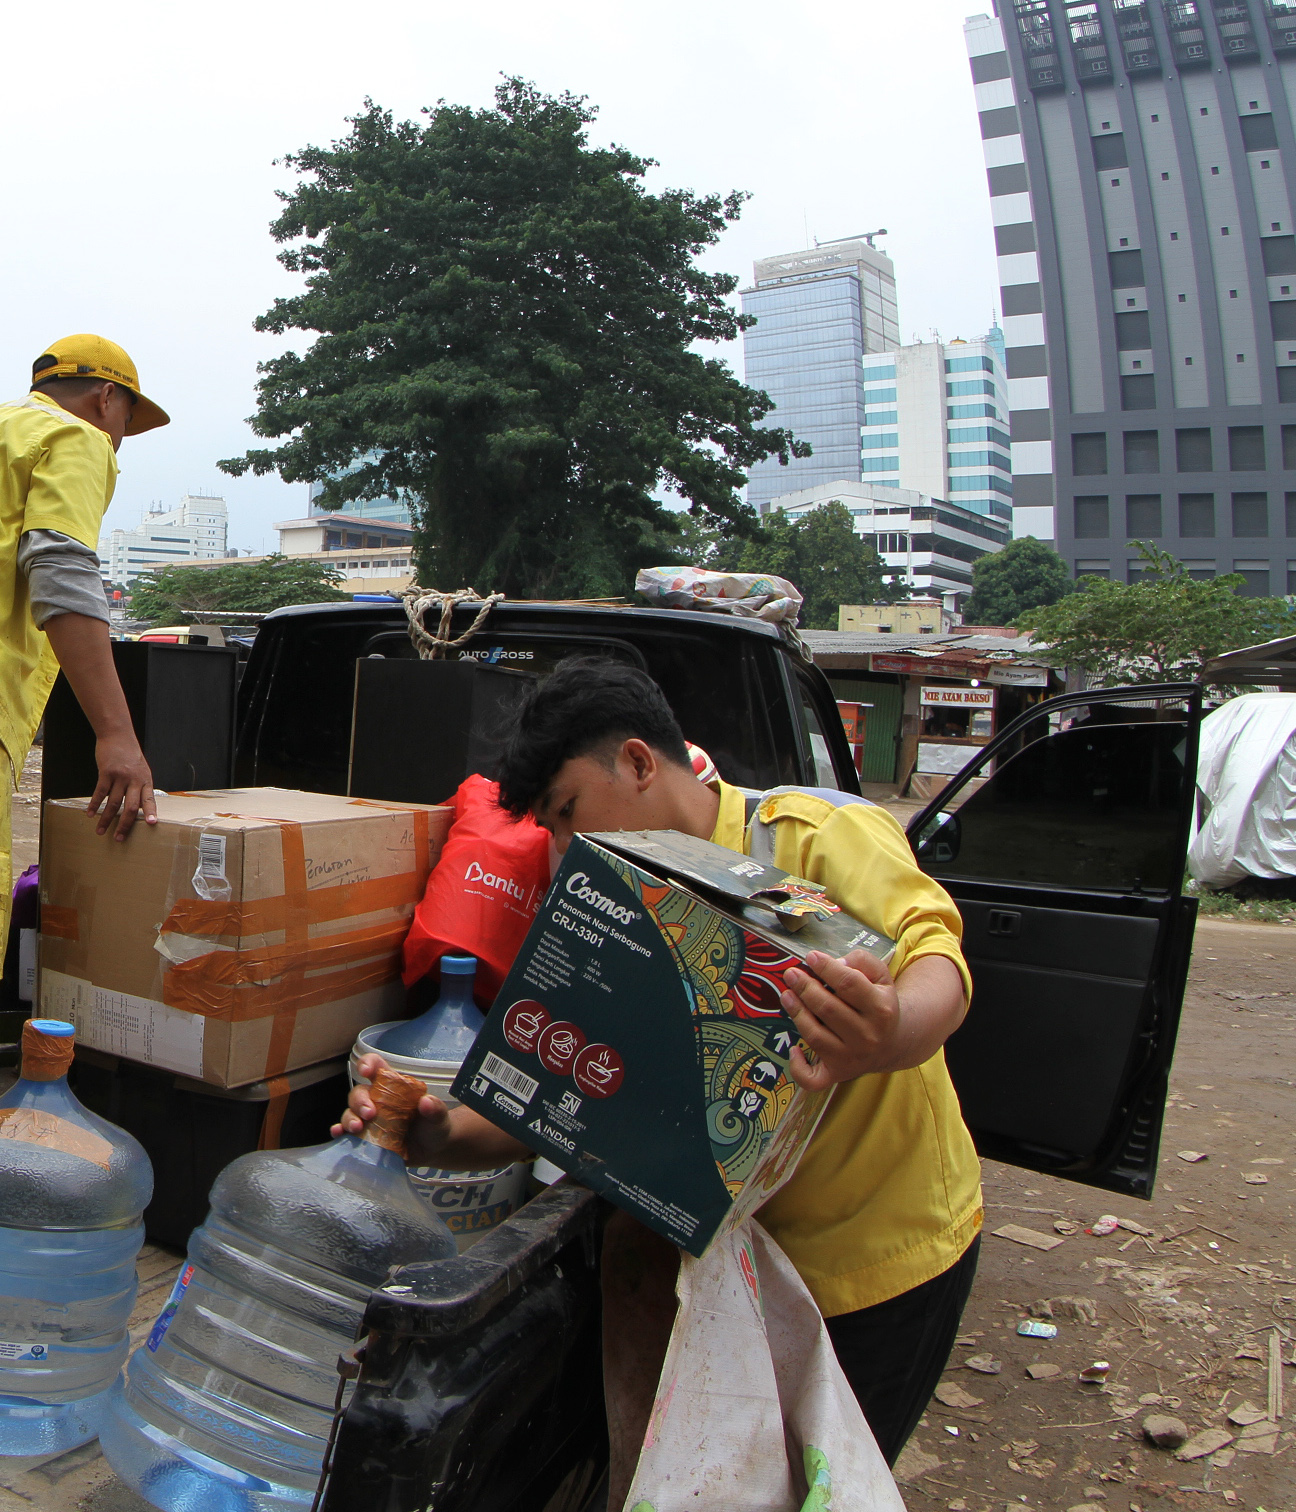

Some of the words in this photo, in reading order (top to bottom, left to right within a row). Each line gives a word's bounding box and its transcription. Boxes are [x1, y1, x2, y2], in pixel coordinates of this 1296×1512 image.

[458, 650, 489, 659] AUTO
[492, 652, 534, 660] CROSS
[924, 691, 939, 701] MIE
[942, 692, 962, 702] AYAM
[964, 694, 990, 704] BAKSO
[464, 862, 524, 900] Bantu
[566, 872, 635, 925] Cosmos
[552, 911, 604, 948] CRJ-3301
[558, 898, 592, 923] Penanak
[592, 918, 610, 934] Nasi
[610, 928, 652, 958] Serbaguna
[496, 1094, 520, 1114] Cosmos
[558, 1090, 582, 1116] SNI
[544, 1124, 576, 1150] INDAG
